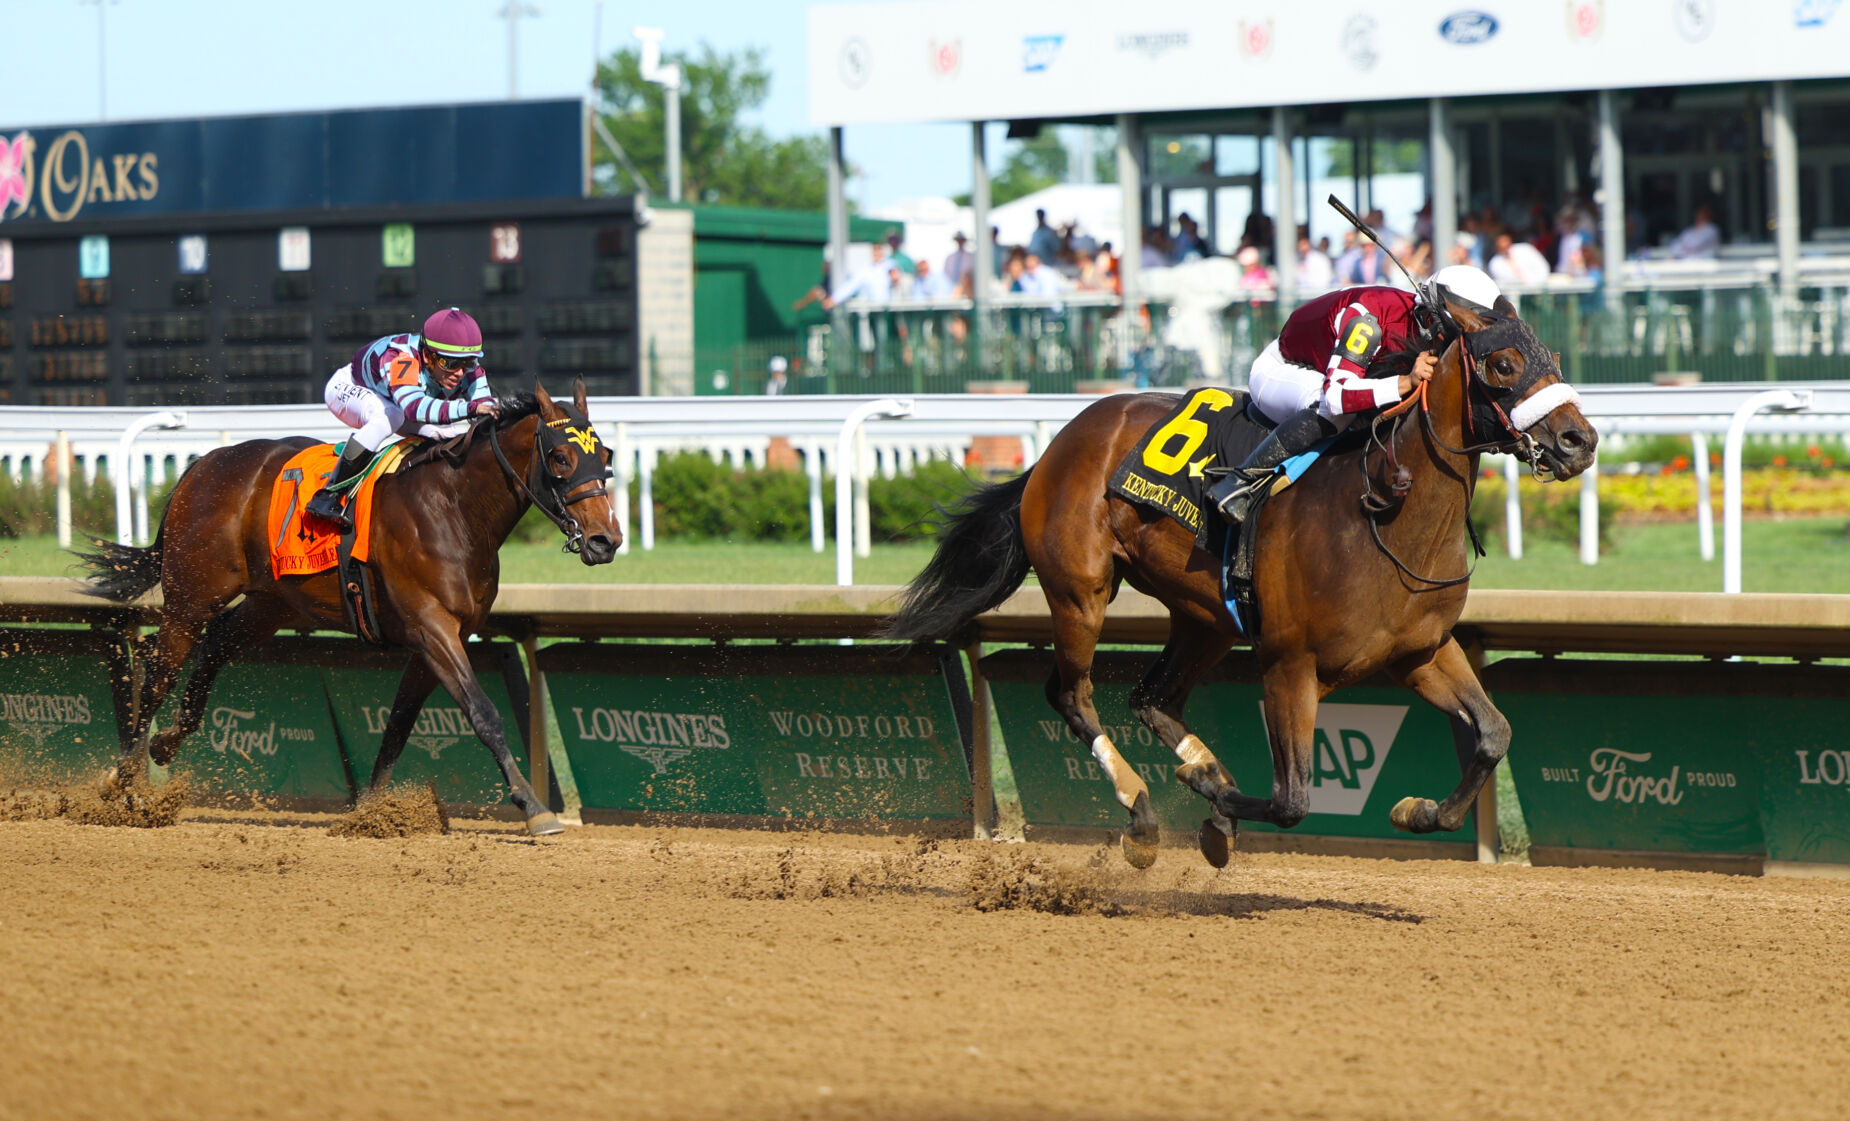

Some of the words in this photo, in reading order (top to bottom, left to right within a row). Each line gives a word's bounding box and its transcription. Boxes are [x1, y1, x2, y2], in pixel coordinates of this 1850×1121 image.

[1345, 322, 1375, 355] 6
[397, 361, 413, 379] 7
[1142, 388, 1234, 476] 6
[276, 467, 304, 549] 7
[276, 555, 305, 570] UCKY
[210, 706, 278, 756] Ford
[280, 727, 315, 741] PROUD
[361, 705, 476, 735] LOGINE
[572, 706, 731, 750] LONGINES
[769, 711, 935, 739] WOODFORD
[1038, 720, 1169, 747] WODFO
[796, 752, 931, 781] RESERVE
[1064, 757, 1181, 783] REERV
[1309, 727, 1376, 789] AP
[1541, 767, 1579, 783] BUILT
[1586, 747, 1684, 806] Ford
[1687, 772, 1737, 788] PROUD
